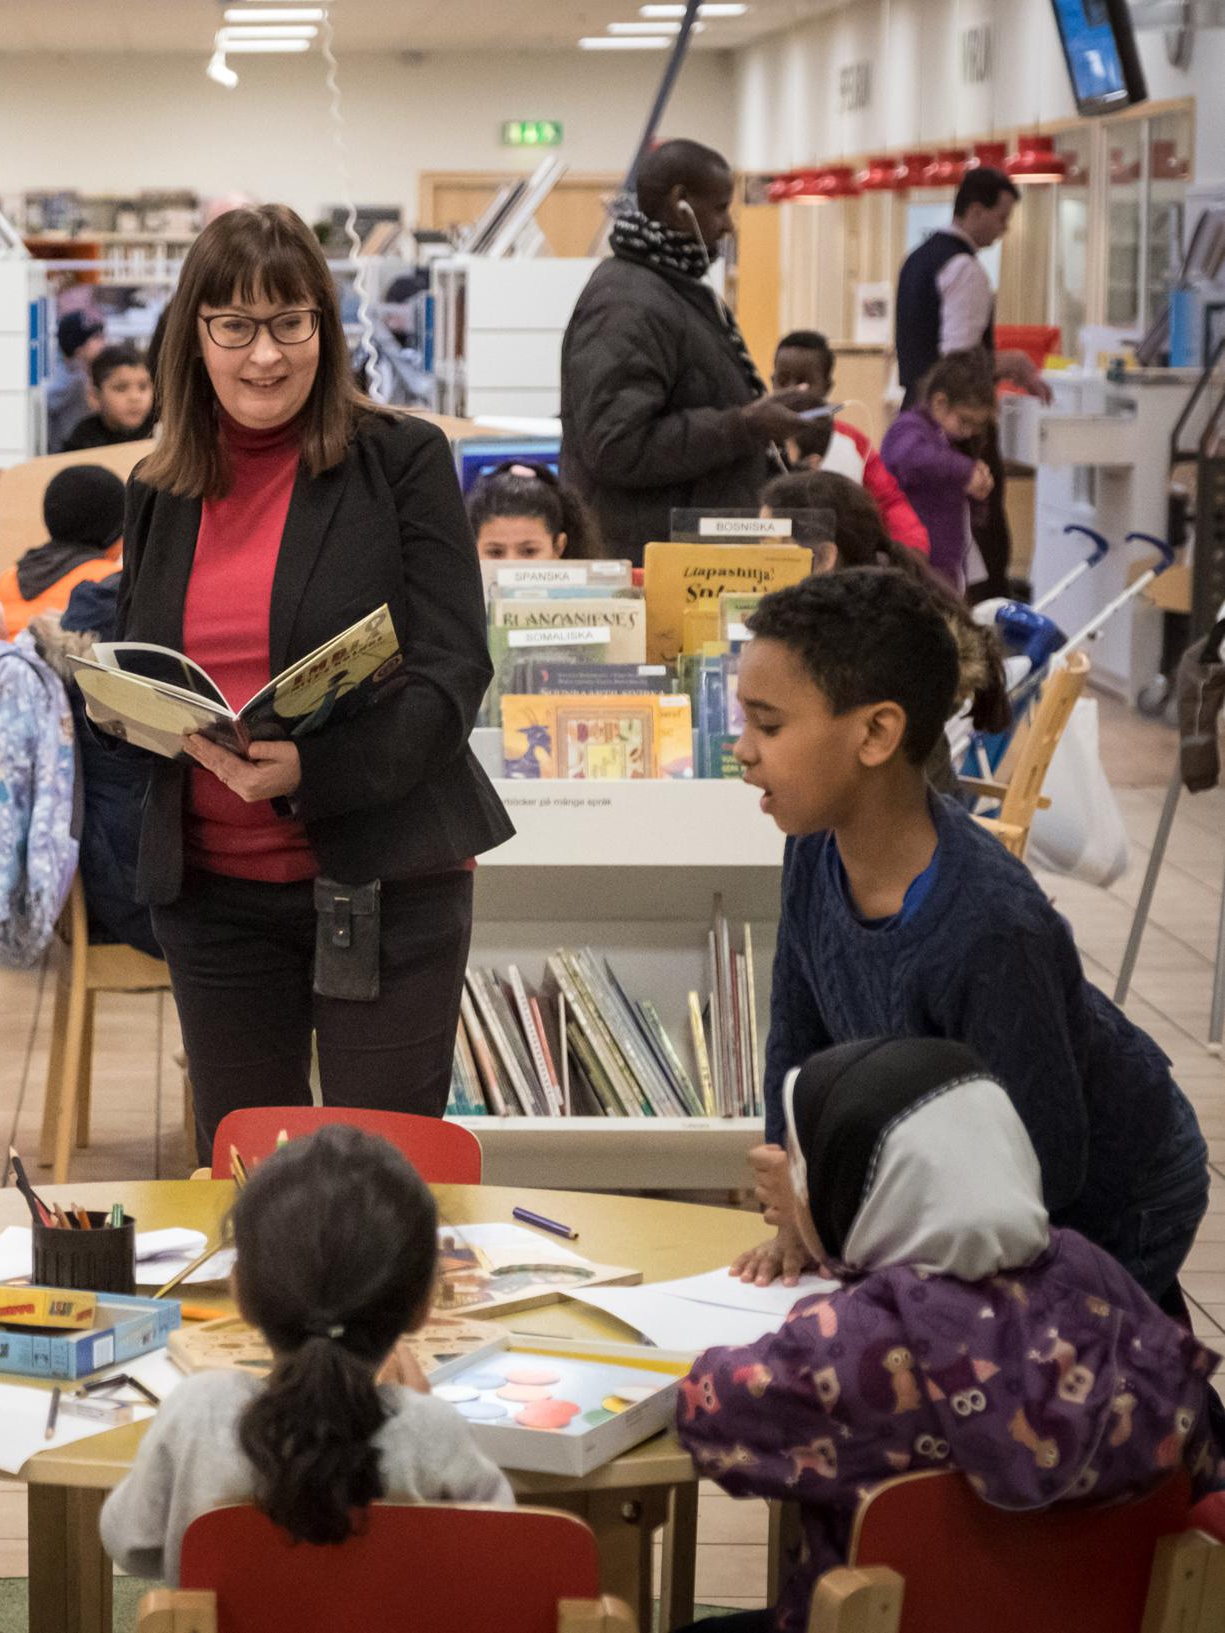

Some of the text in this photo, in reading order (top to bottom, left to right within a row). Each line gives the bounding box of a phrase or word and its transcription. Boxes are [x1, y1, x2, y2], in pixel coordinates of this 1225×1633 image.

[716, 522, 775, 531] BOSNISKA
[514, 571, 570, 581] SPANSKA
[526, 631, 594, 642] SOMALISKA
